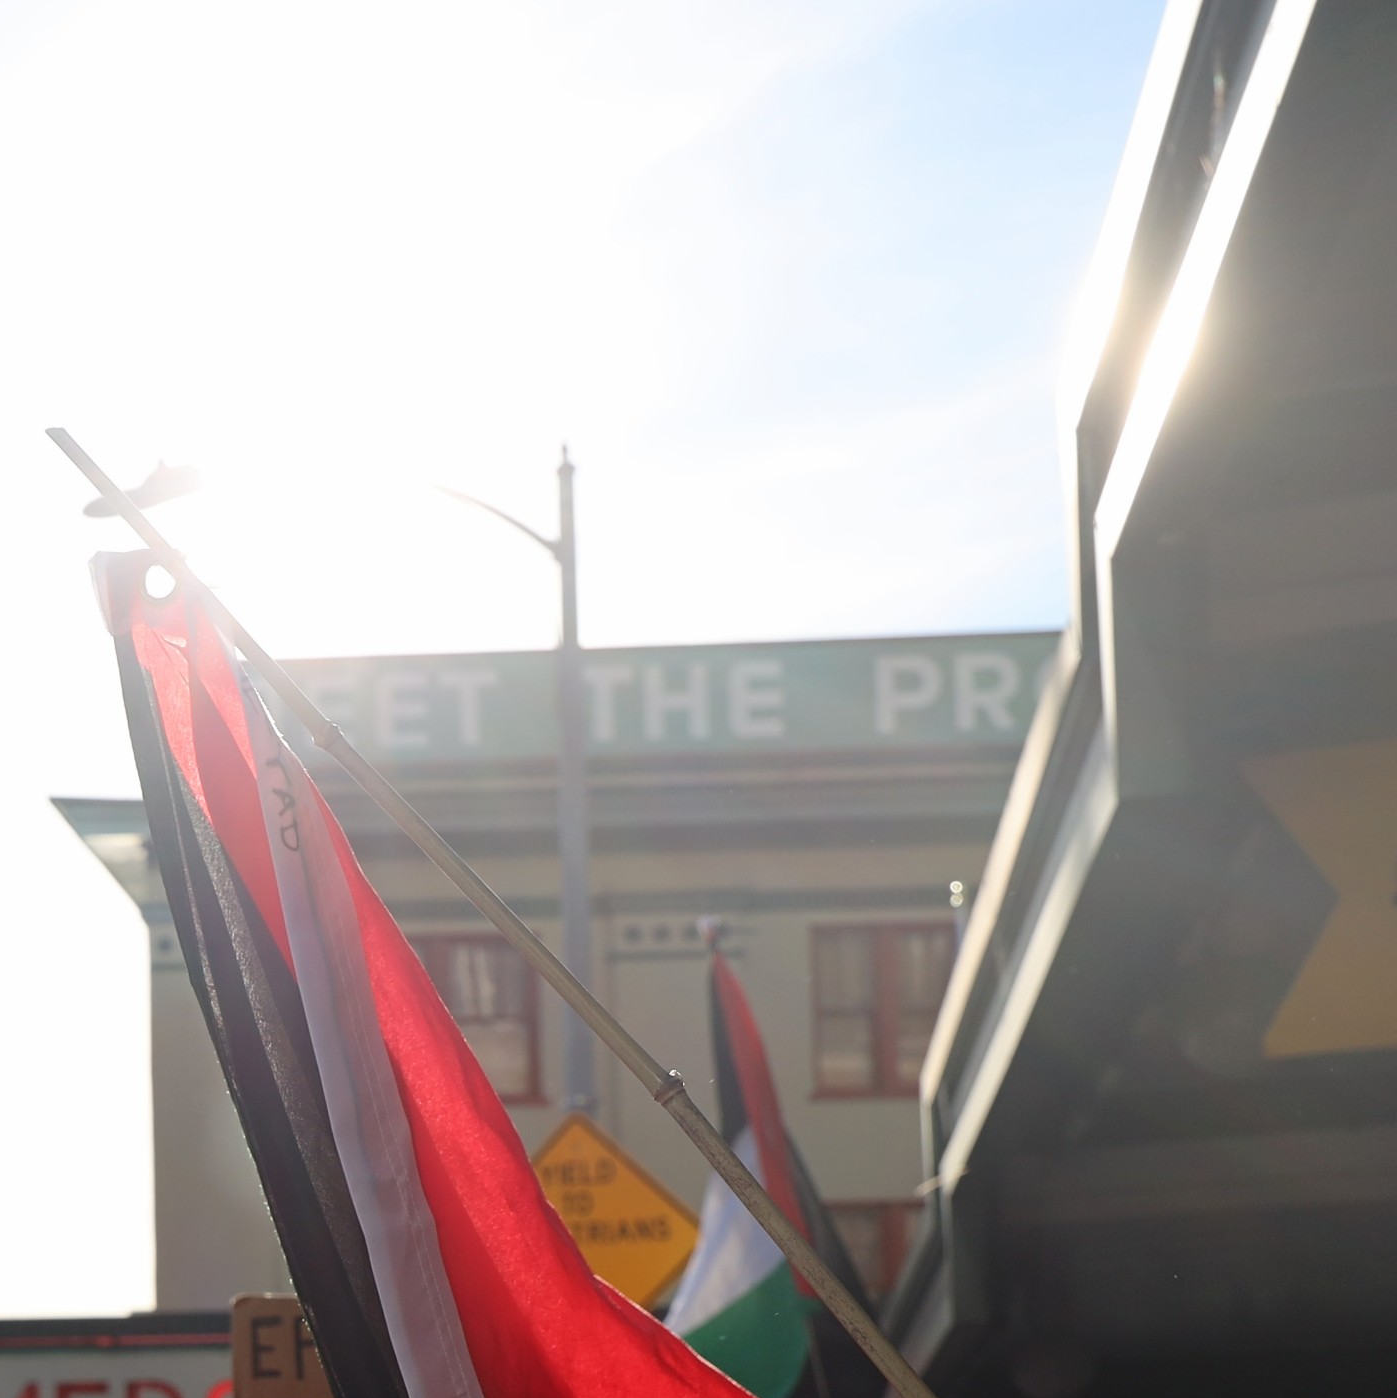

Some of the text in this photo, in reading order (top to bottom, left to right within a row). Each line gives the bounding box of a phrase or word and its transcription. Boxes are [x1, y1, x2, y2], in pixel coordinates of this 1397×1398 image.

[305, 666, 499, 748] EET
[583, 660, 787, 743] THE
[560, 1190, 595, 1217] TO
